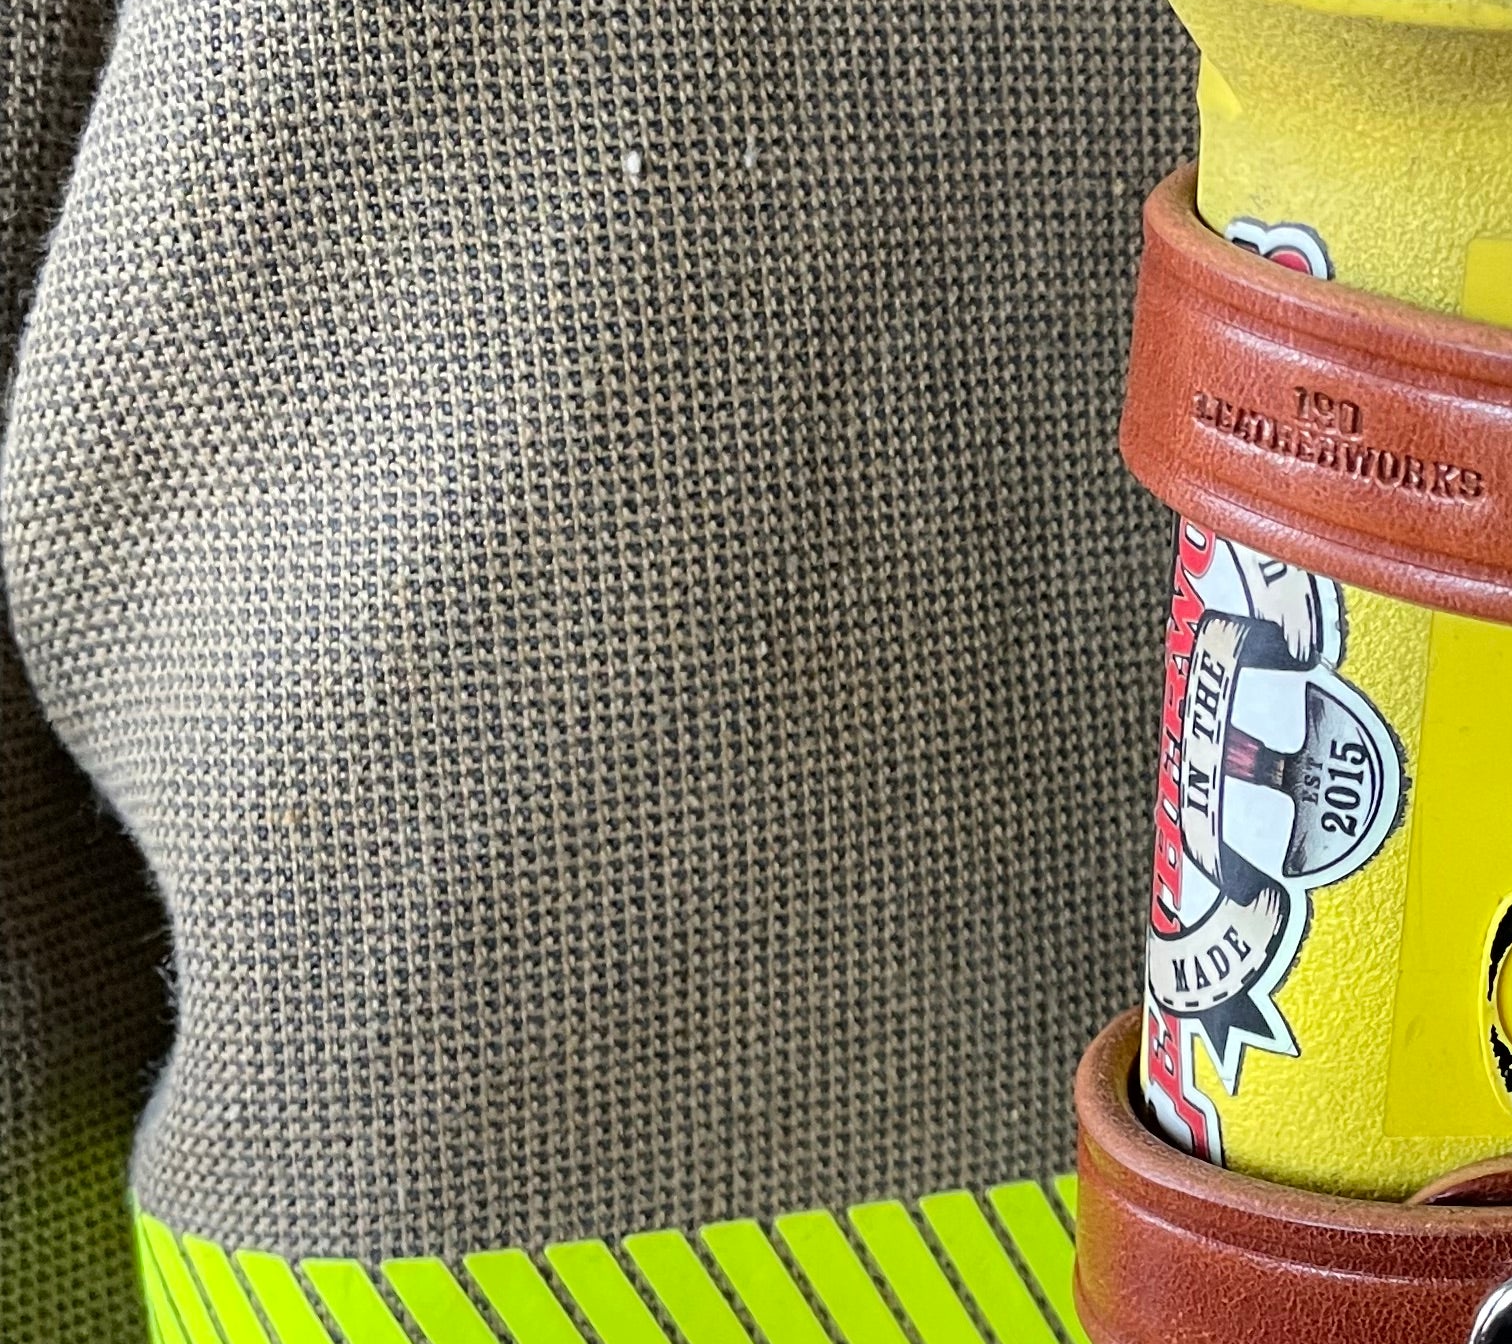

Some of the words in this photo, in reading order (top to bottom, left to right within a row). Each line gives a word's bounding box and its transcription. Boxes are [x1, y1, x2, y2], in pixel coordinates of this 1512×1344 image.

[1193, 390, 1484, 499] LEATHERWORKS
[1191, 650, 1228, 744] THE
[1186, 763, 1210, 818] IN
[1301, 756, 1324, 805] EST
[1321, 739, 1371, 838] 2015
[1171, 924, 1252, 993] MADE
